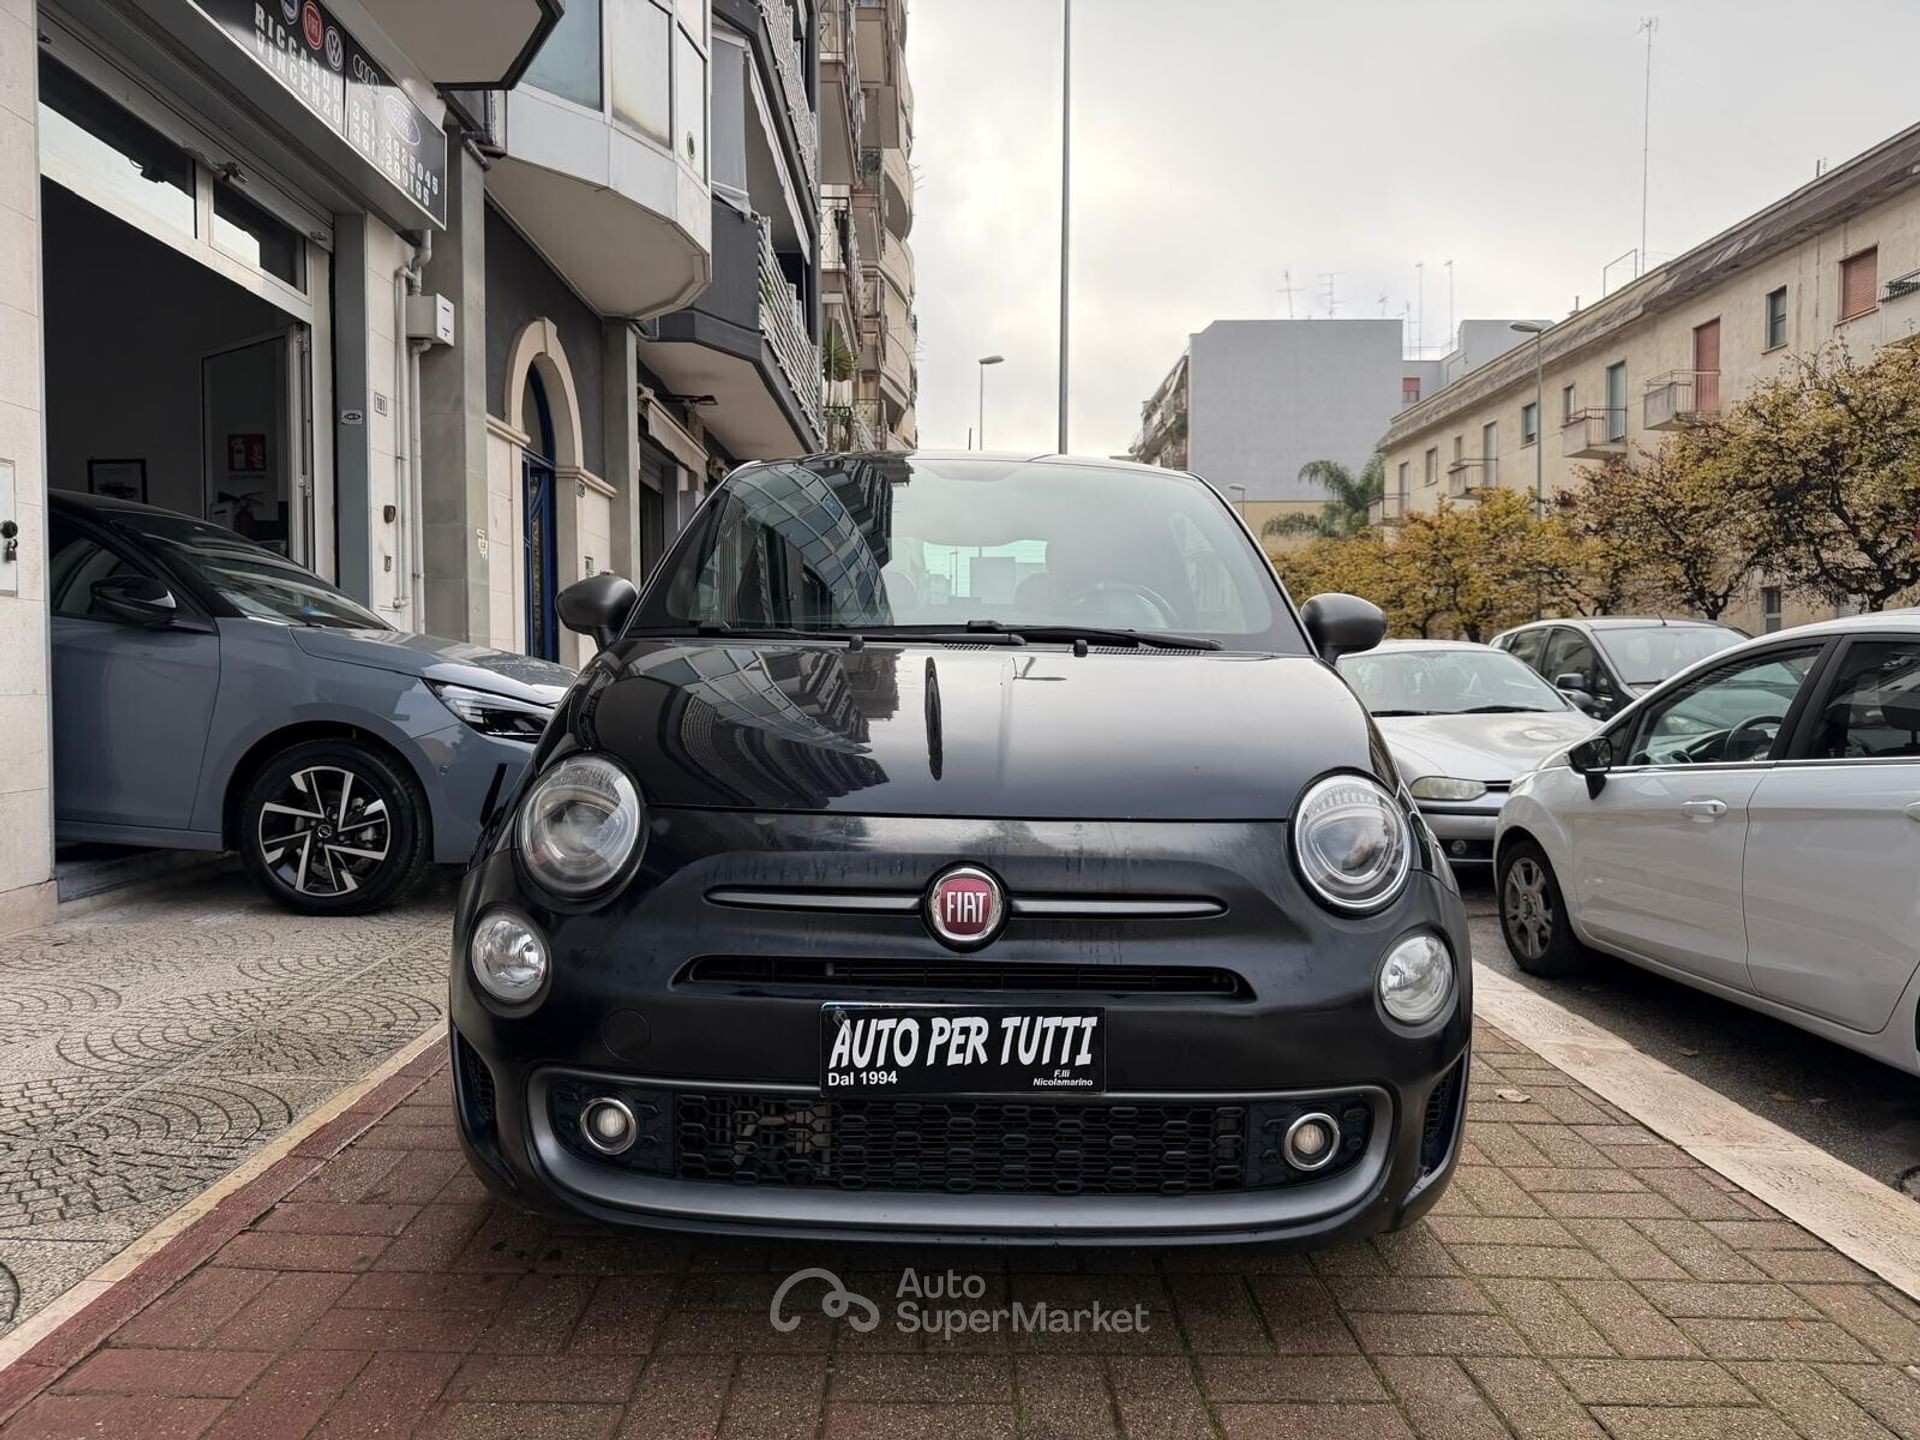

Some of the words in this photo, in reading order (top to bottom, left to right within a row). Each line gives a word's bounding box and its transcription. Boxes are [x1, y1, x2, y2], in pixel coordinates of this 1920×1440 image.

[255, 2, 341, 100] RICCARDO
[946, 891, 987, 923] FIAT
[828, 1017, 920, 1069] AUTO
[926, 1016, 989, 1066] PER
[1000, 1016, 1098, 1066] TUTTI
[828, 1072, 854, 1087] Dal
[859, 1071, 898, 1086] 1994
[1033, 1078, 1093, 1087] Nicolamarino
